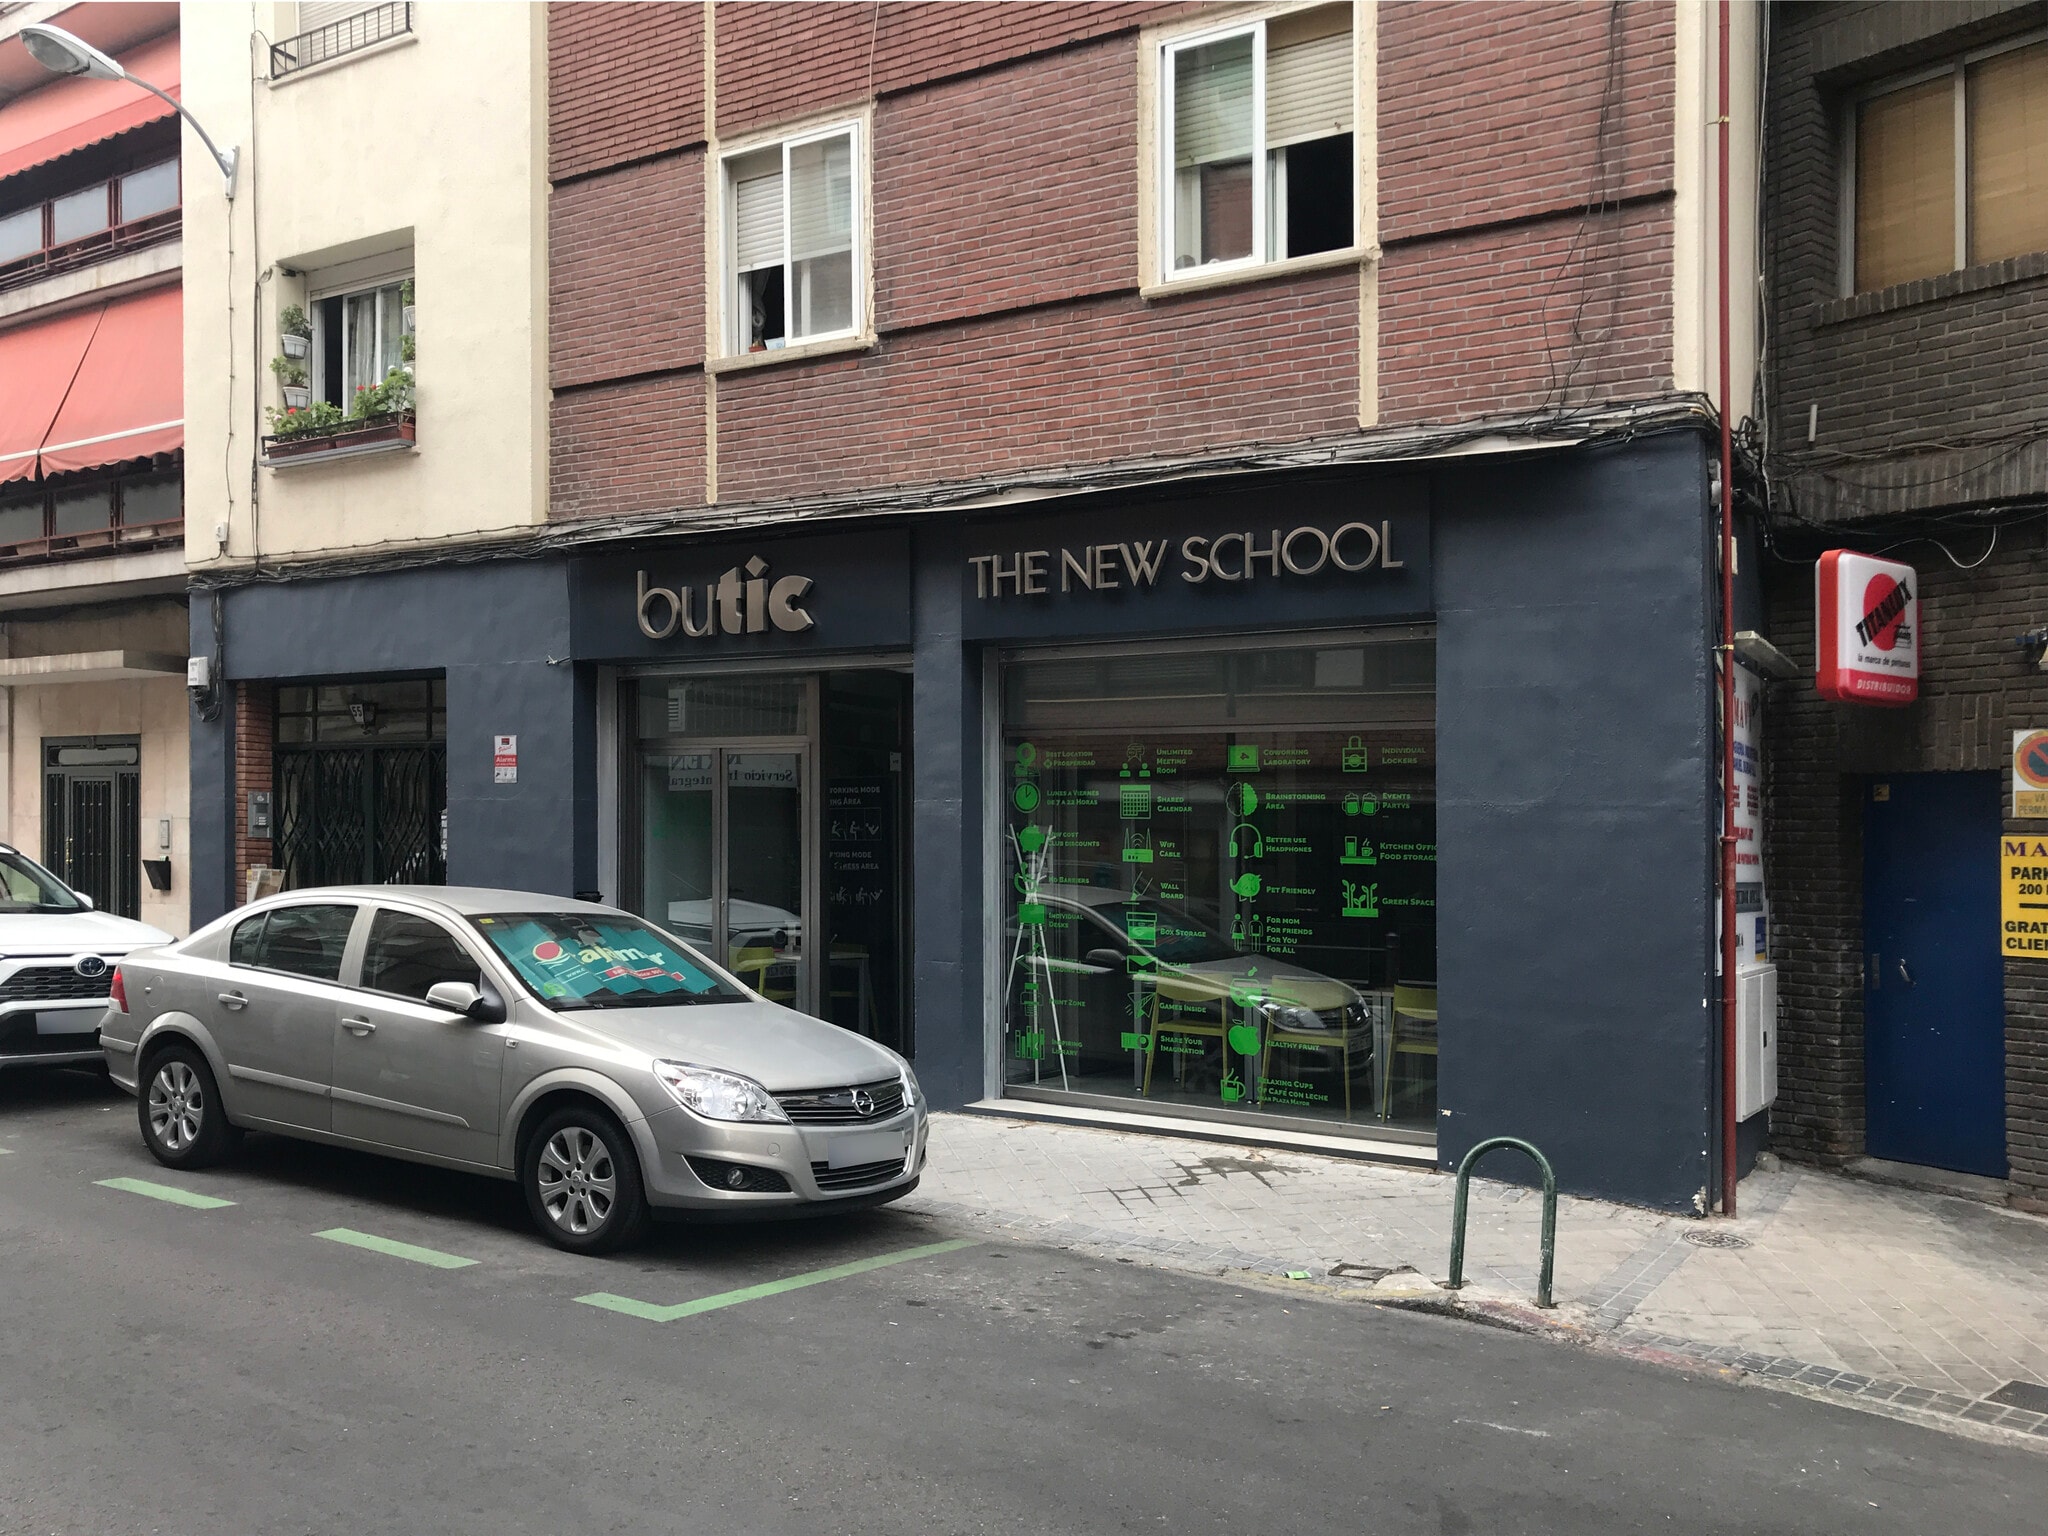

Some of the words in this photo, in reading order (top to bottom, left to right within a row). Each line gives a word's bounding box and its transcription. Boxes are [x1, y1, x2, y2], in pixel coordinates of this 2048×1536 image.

[968, 550, 1049, 599] THE
[1061, 539, 1168, 592] NEW
[1181, 520, 1404, 584] SCHOOL
[637, 555, 814, 639] butic
[1857, 679, 1912, 695] DISTRIBUIDOR
[1266, 886, 1280, 894] PET
[1282, 887, 1316, 895] FRIENDLY
[2018, 883, 2043, 895] 200
